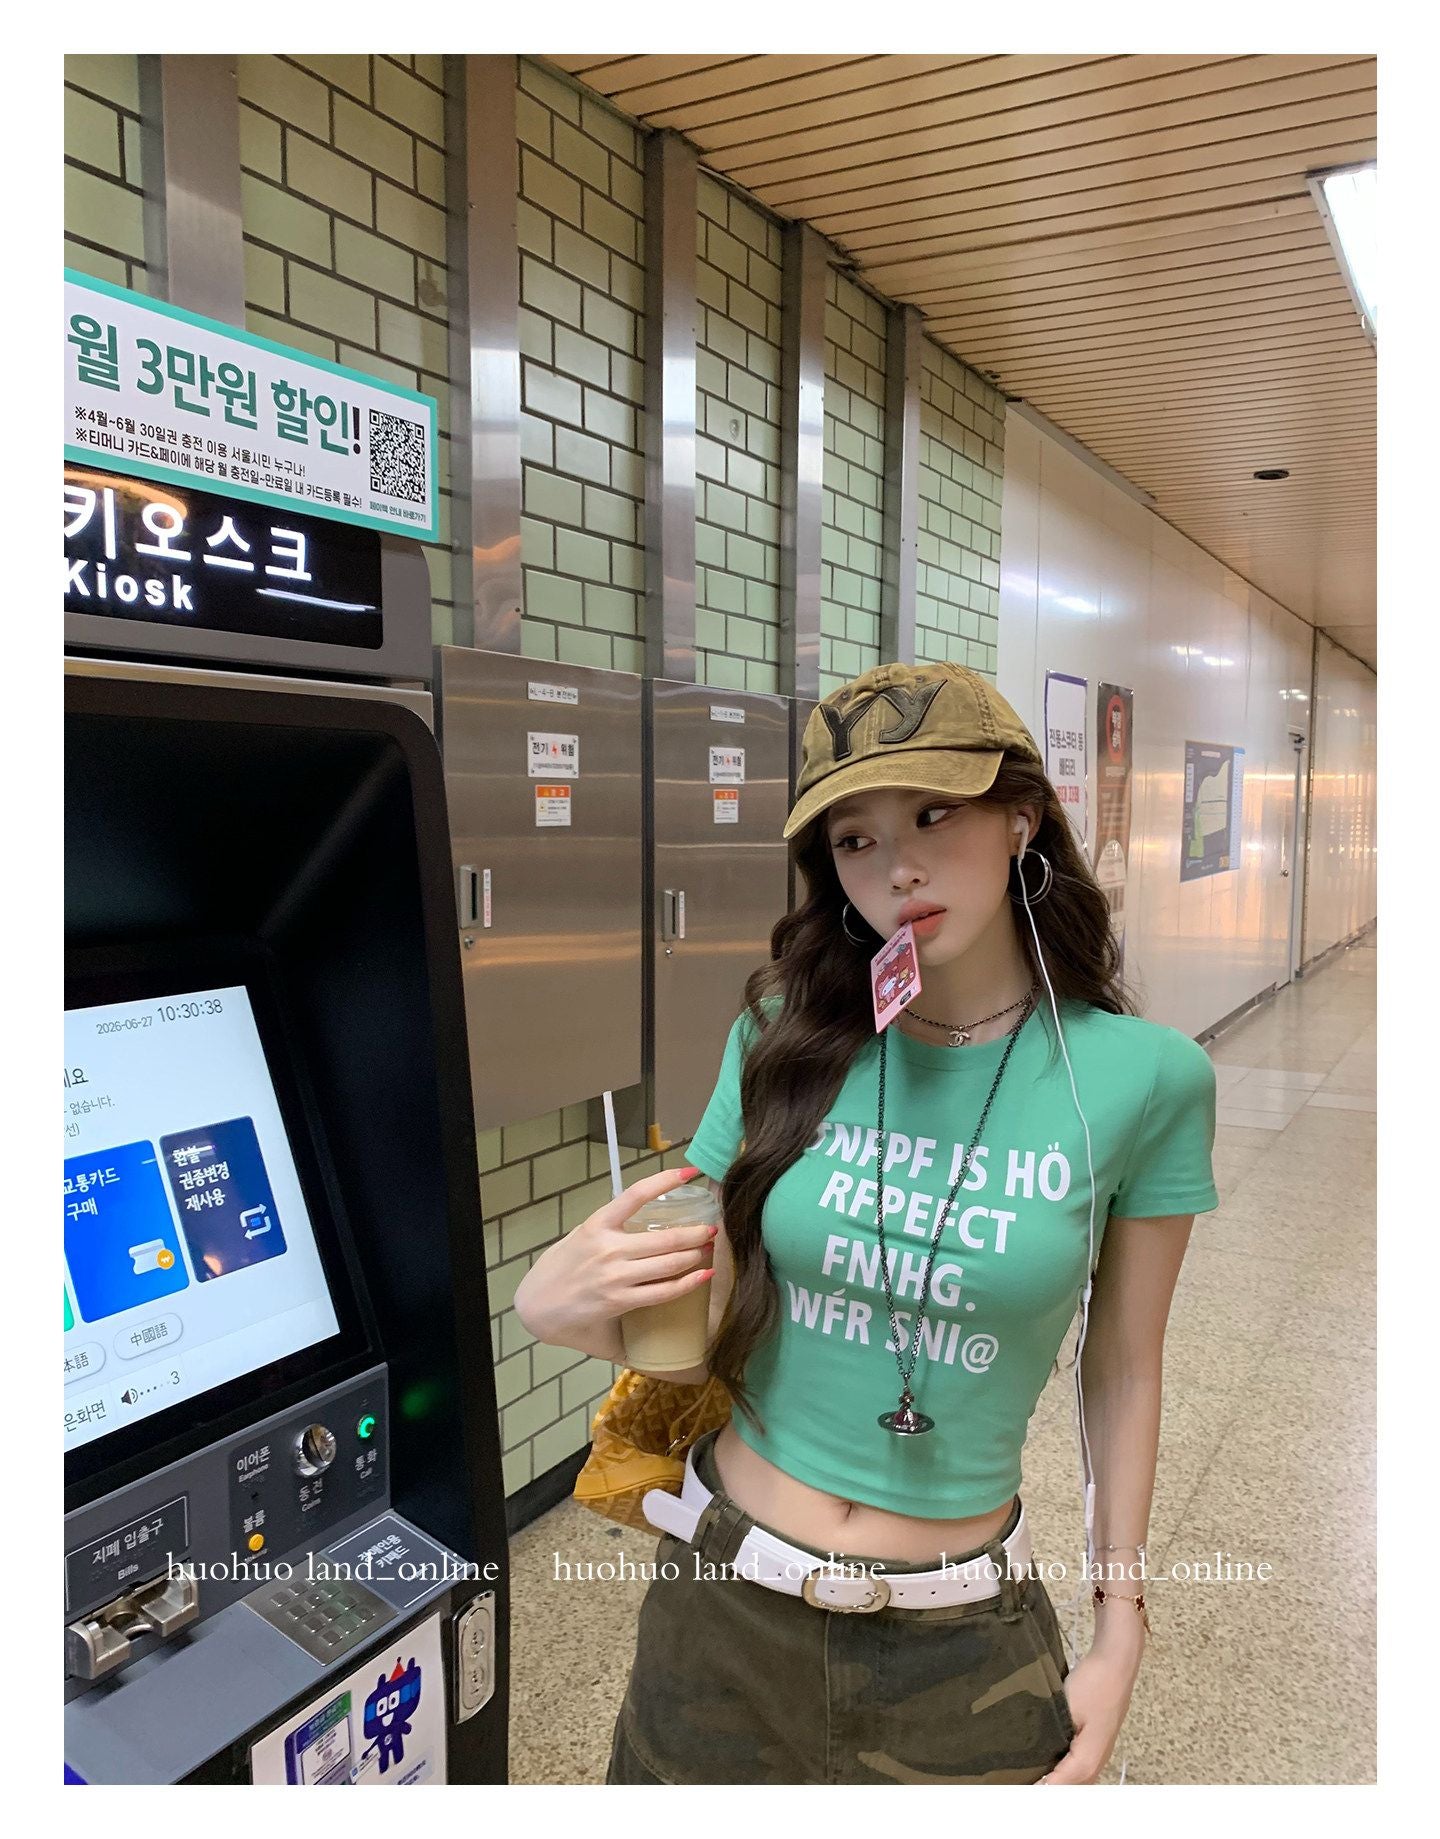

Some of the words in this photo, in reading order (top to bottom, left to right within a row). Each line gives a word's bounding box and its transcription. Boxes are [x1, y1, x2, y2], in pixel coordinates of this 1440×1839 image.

[67, 314, 121, 392] 월
[135, 337, 258, 431] 3만원
[270, 378, 362, 457] 할인!
[140, 422, 178, 446] 30일권
[181, 433, 203, 452] 충전
[206, 440, 228, 458] 이용
[231, 446, 271, 470] 서울시민
[274, 457, 306, 477] 누구나!
[127, 439, 191, 468] 카드&페이에
[194, 456, 215, 474] 해당
[218, 461, 228, 478] 월
[295, 481, 304, 496] 내
[306, 483, 341, 505] 카드등록
[64, 484, 313, 582] 키오스크
[64, 556, 195, 612] Kiosk
[96, 1015, 153, 1035] 2026-06-27
[157, 998, 223, 1023] 10:30:38
[69, 1094, 116, 1116] 없습니다.
[64, 1167, 121, 1196] 교통카드
[178, 1160, 231, 1191] 권종변경
[947, 1141, 990, 1193] IS
[66, 1197, 99, 1222] 구매
[184, 1187, 226, 1212] 재사용
[130, 1321, 169, 1347] 中國語
[170, 1370, 180, 1385] 3
[64, 1399, 107, 1433] 은화면
[236, 1445, 271, 1471] 이어폰
[243, 1509, 267, 1534] 볼륨
[92, 1539, 120, 1565] 지폐
[124, 1518, 164, 1551] 입출구
[117, 1563, 139, 1581] Bills
[375, 1545, 411, 1569] 키패드
